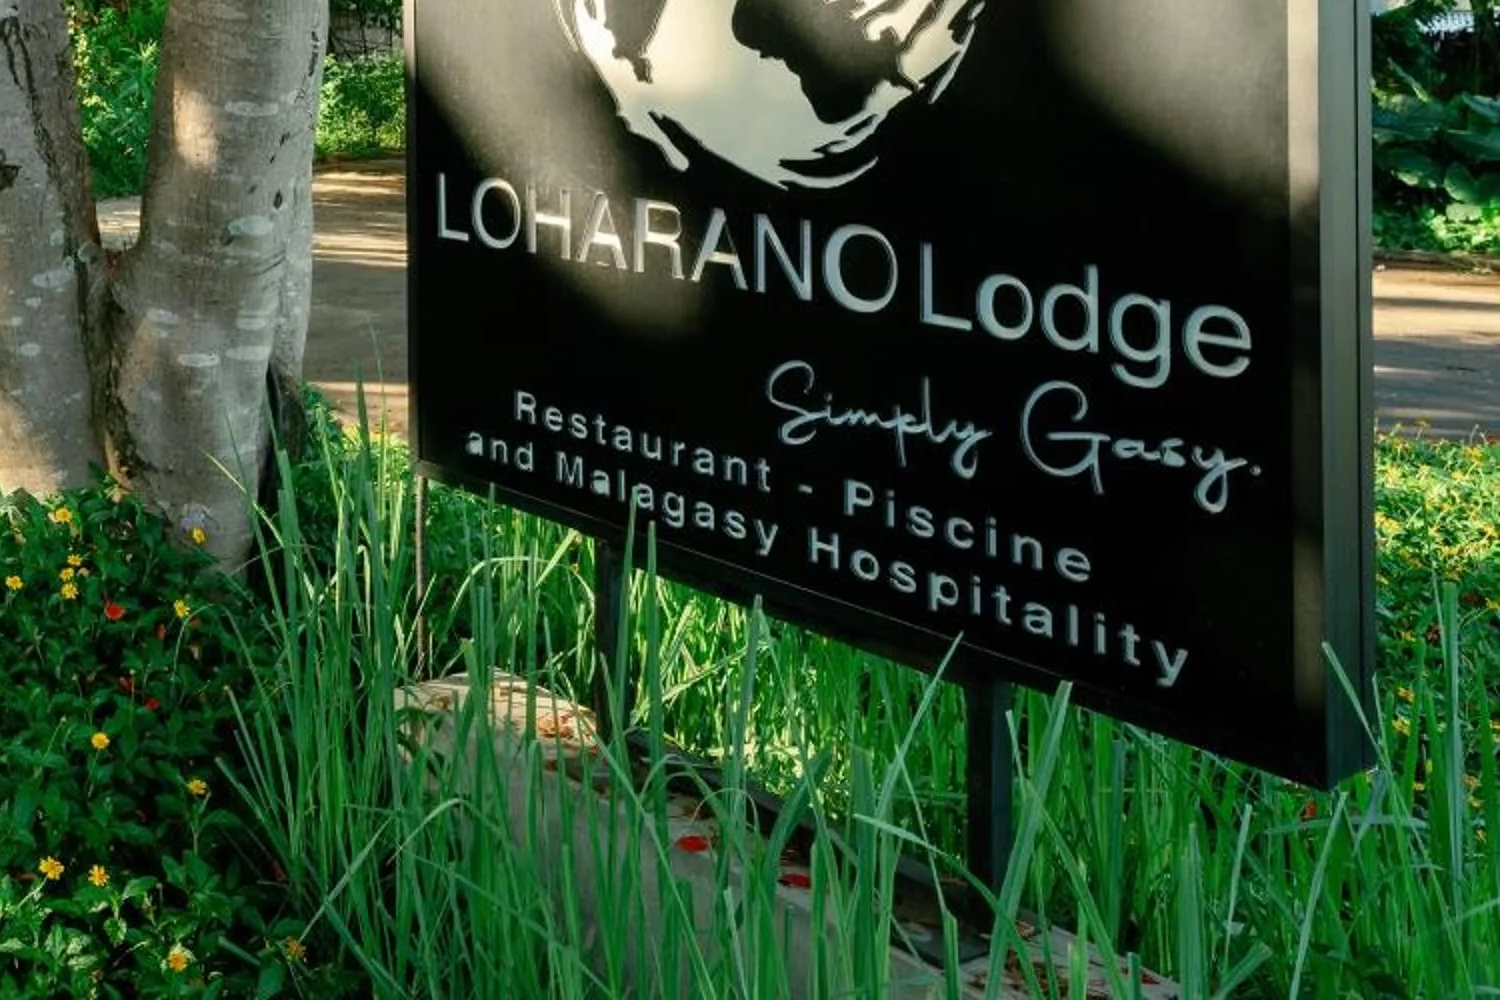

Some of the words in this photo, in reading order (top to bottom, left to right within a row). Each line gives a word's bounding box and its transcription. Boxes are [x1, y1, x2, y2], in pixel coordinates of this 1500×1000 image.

[435, 171, 900, 313] LOHARANO
[920, 241, 1253, 389] Lodge
[515, 390, 772, 493] Restaurant
[844, 478, 1093, 584] Piscine
[767, 360, 993, 479] Simply
[1020, 380, 1264, 514] Gasy.
[466, 431, 534, 473] and
[556, 451, 779, 557] Malagasy
[808, 527, 1188, 686] Hospitality
